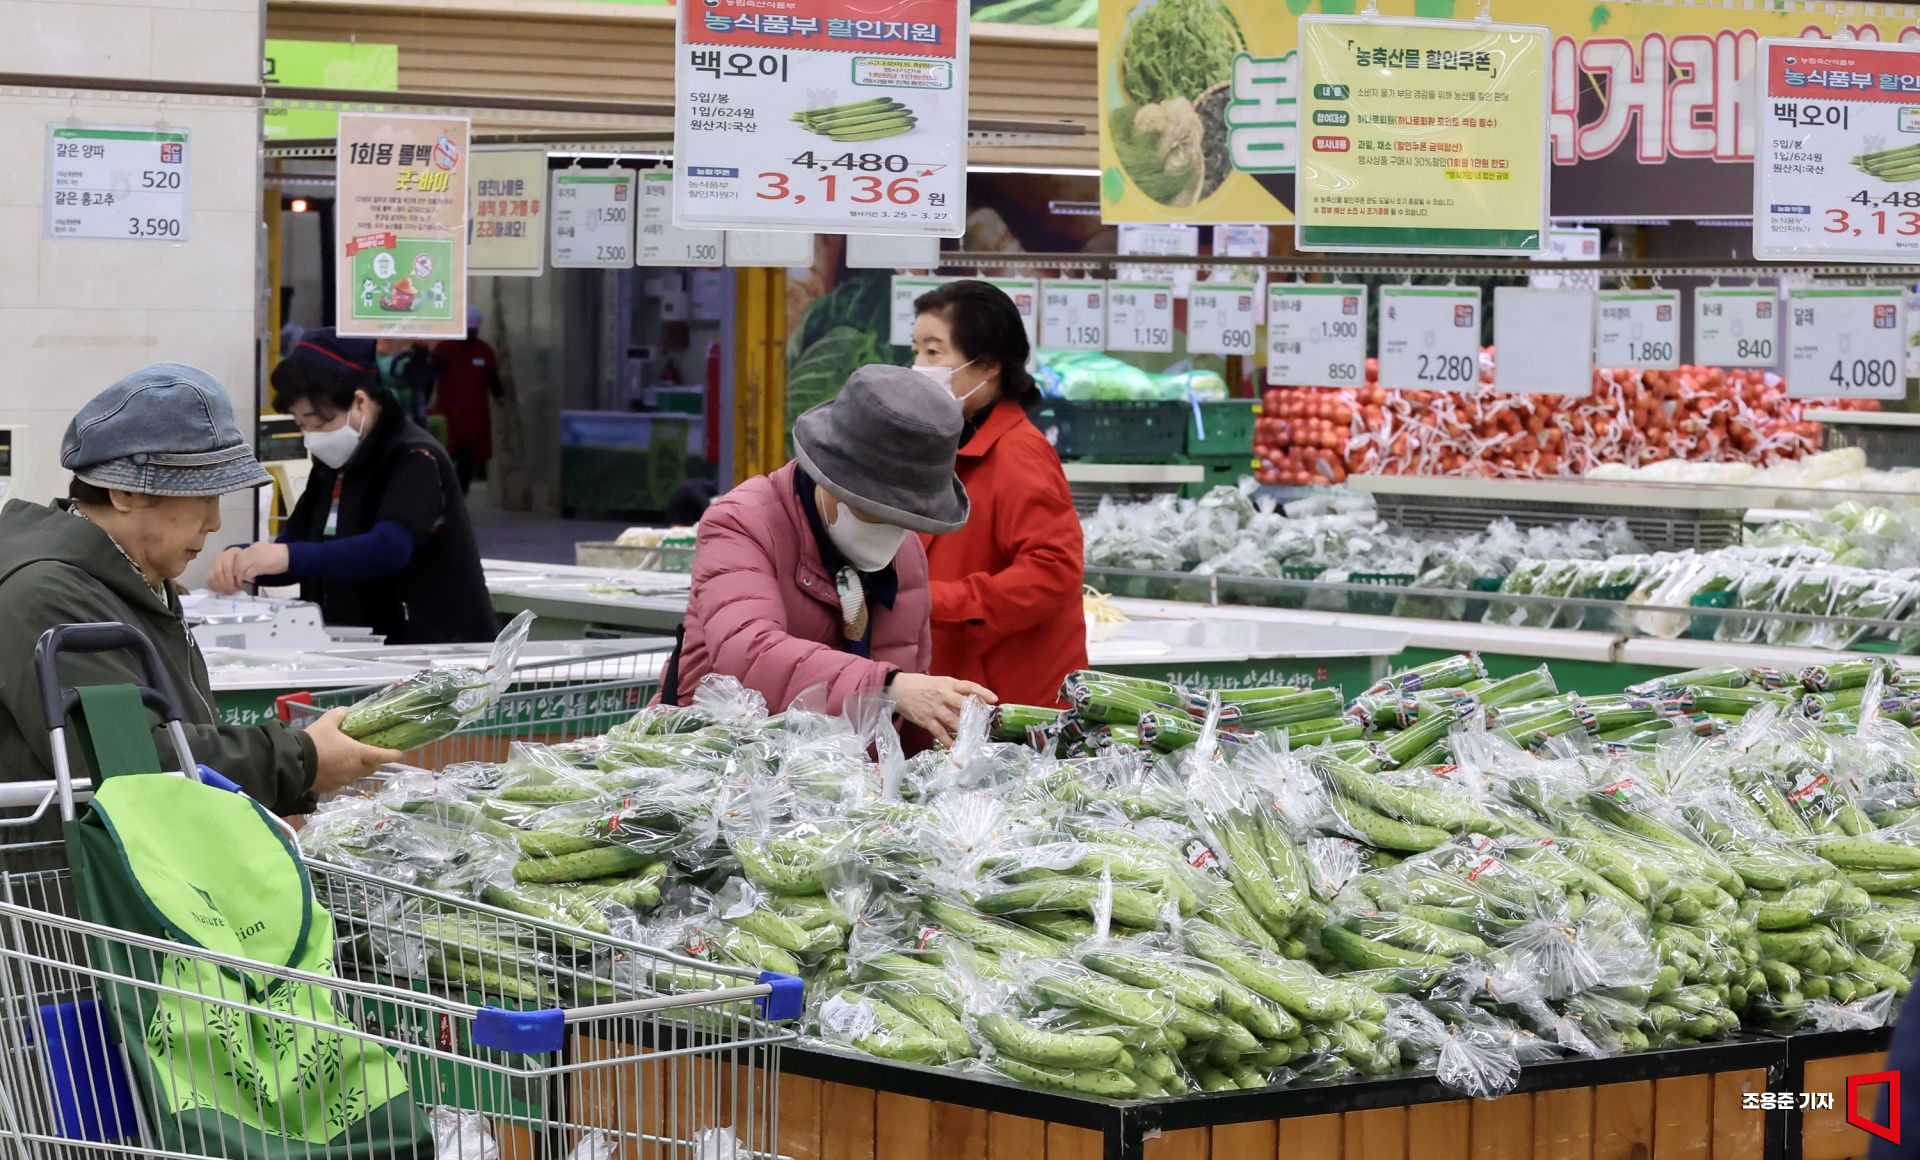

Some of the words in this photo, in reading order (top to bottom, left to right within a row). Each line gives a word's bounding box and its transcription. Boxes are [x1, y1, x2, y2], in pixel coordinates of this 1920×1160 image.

[704, 11, 819, 36] 농식품부
[827, 18, 938, 43] 할인지원
[691, 51, 788, 82] 백오이
[1784, 68, 1873, 89] 농식품부
[690, 91, 731, 104] 5입/봉
[1357, 88, 1380, 98] 소비자
[1381, 89, 1396, 99] 물가
[1397, 90, 1412, 99] 부담
[691, 105, 755, 119] 1입/624원
[1316, 113, 1347, 124] 참여대상
[1774, 103, 1848, 131] 백오이
[690, 119, 758, 134] 원산지:국산
[82, 144, 105, 159] 양파
[1773, 139, 1803, 150] 5입/봉
[350, 142, 394, 167] 1회용
[397, 148, 433, 167] 롤백
[791, 151, 909, 175] 4,480
[1773, 151, 1823, 162] 1입/624원
[1773, 163, 1825, 174] 원산지:국산
[142, 171, 181, 189] 520
[756, 171, 921, 206] 3,136
[927, 192, 947, 207] 원
[81, 192, 116, 207] 홍고추
[598, 207, 627, 223] 1,500
[128, 217, 181, 238] 3,590
[597, 246, 627, 261] 2,500
[687, 244, 716, 261] 1,500
[1066, 326, 1100, 345] 1,150
[1134, 328, 1168, 346] 1,150
[1222, 329, 1252, 348] 690
[1322, 321, 1358, 338] 1,900
[1629, 341, 1672, 362] 1,860
[1737, 339, 1772, 359] 840
[1328, 363, 1357, 381] 850
[1417, 354, 1474, 383] 2,280
[1829, 359, 1897, 389] 4,080
[191, 911, 226, 927] Nature
